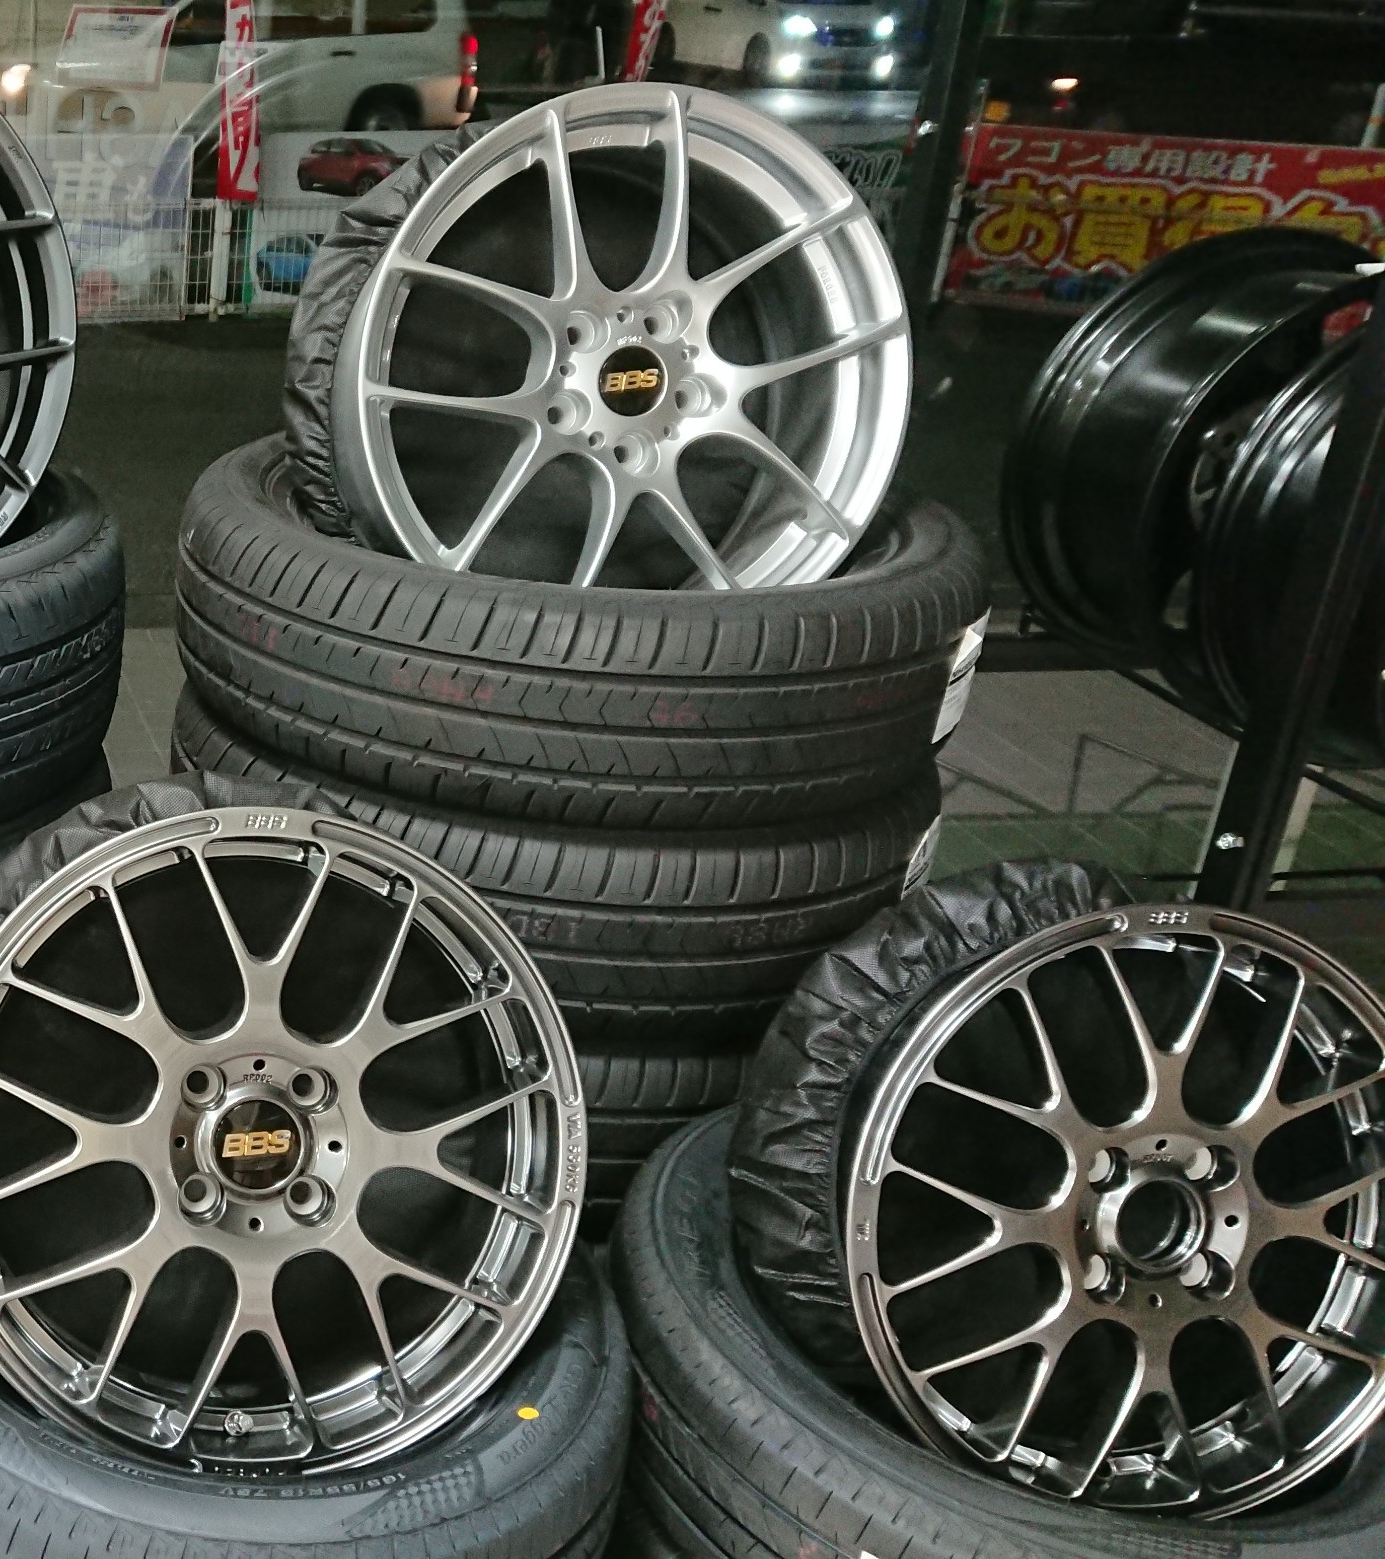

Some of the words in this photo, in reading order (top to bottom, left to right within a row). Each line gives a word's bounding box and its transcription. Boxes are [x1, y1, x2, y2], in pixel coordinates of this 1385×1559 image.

[987, 136, 1277, 184] ワゴン専用設計
[604, 368, 659, 393] BBS
[222, 1129, 292, 1158] BBS
